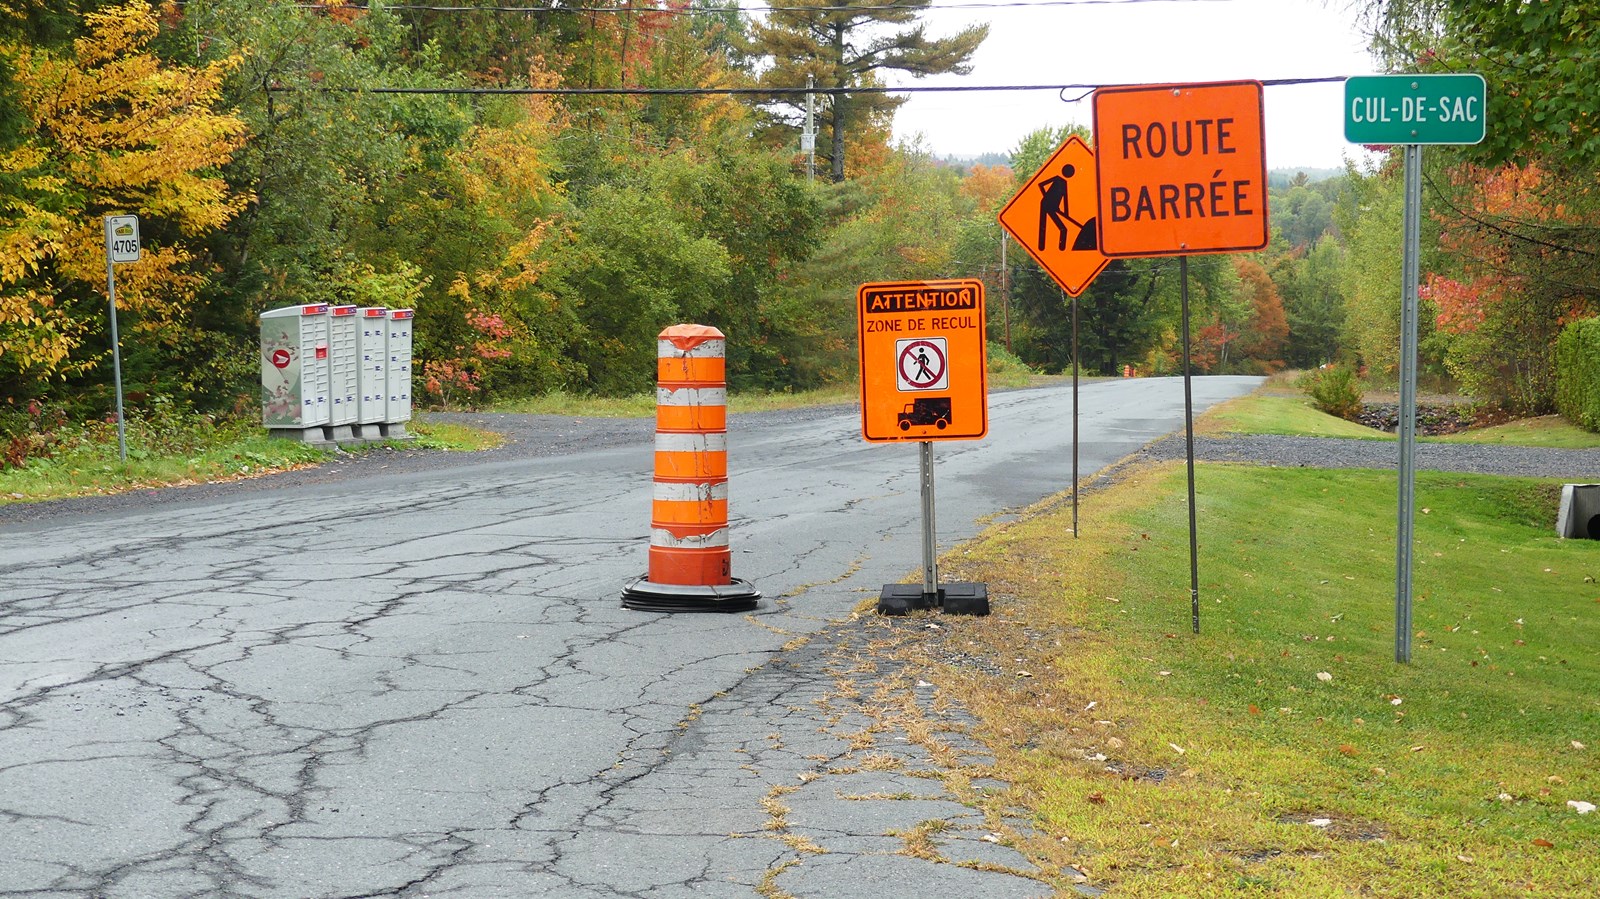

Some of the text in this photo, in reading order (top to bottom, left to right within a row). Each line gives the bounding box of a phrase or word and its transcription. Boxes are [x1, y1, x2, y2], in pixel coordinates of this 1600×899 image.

[1352, 96, 1477, 122] CUL-DE-SAC
[1122, 118, 1236, 159] ROUTE
[1110, 169, 1253, 222] BARRÉE
[113, 240, 137, 253] 4705
[871, 290, 971, 310] ATTENTION
[866, 316, 976, 333] ZONE DE RECUL
